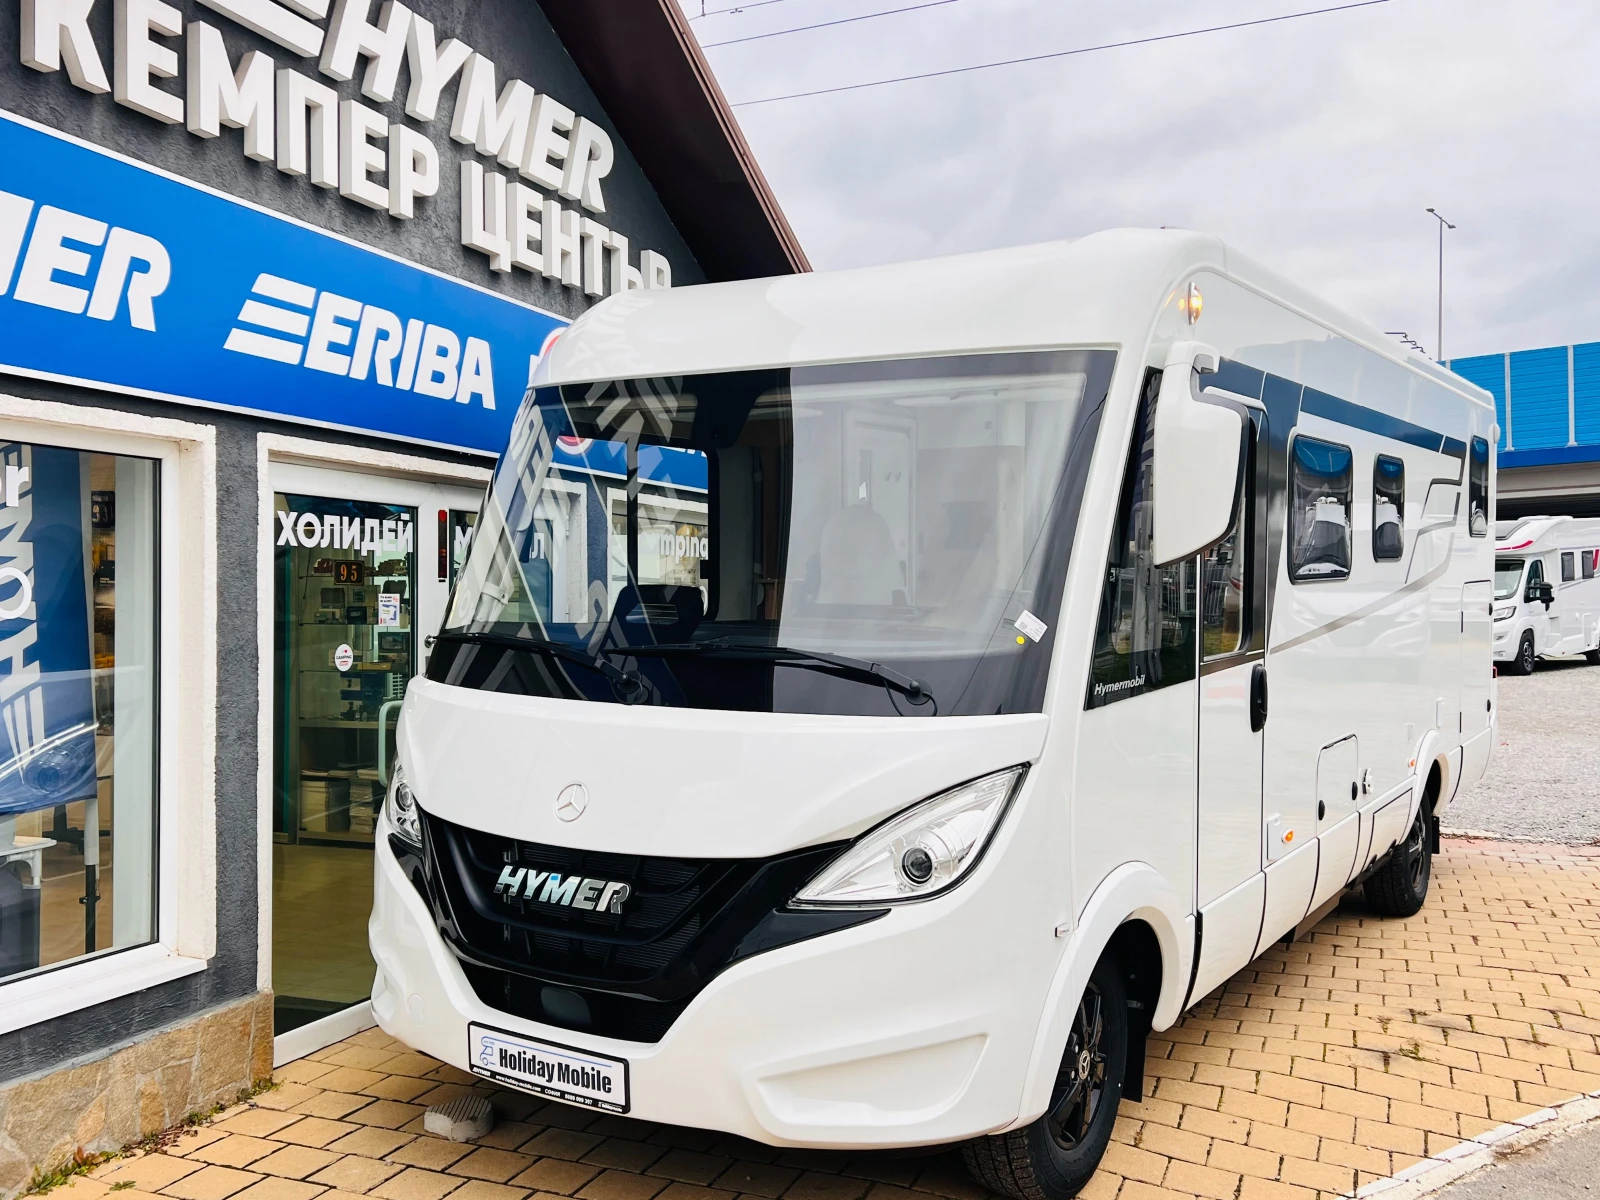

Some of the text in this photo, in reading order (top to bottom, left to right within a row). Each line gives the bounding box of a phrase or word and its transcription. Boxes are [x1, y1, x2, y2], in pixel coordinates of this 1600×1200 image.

[20, 0, 440, 219] КЕМПЕР
[318, 0, 615, 213] HYMER
[304, 291, 497, 410] ERIBA
[276, 510, 414, 557] ХОЛИДЕЙ
[1093, 674, 1146, 697] Hymermobil
[494, 865, 631, 914] HYMER
[499, 1048, 612, 1094] Holiday Mobile
